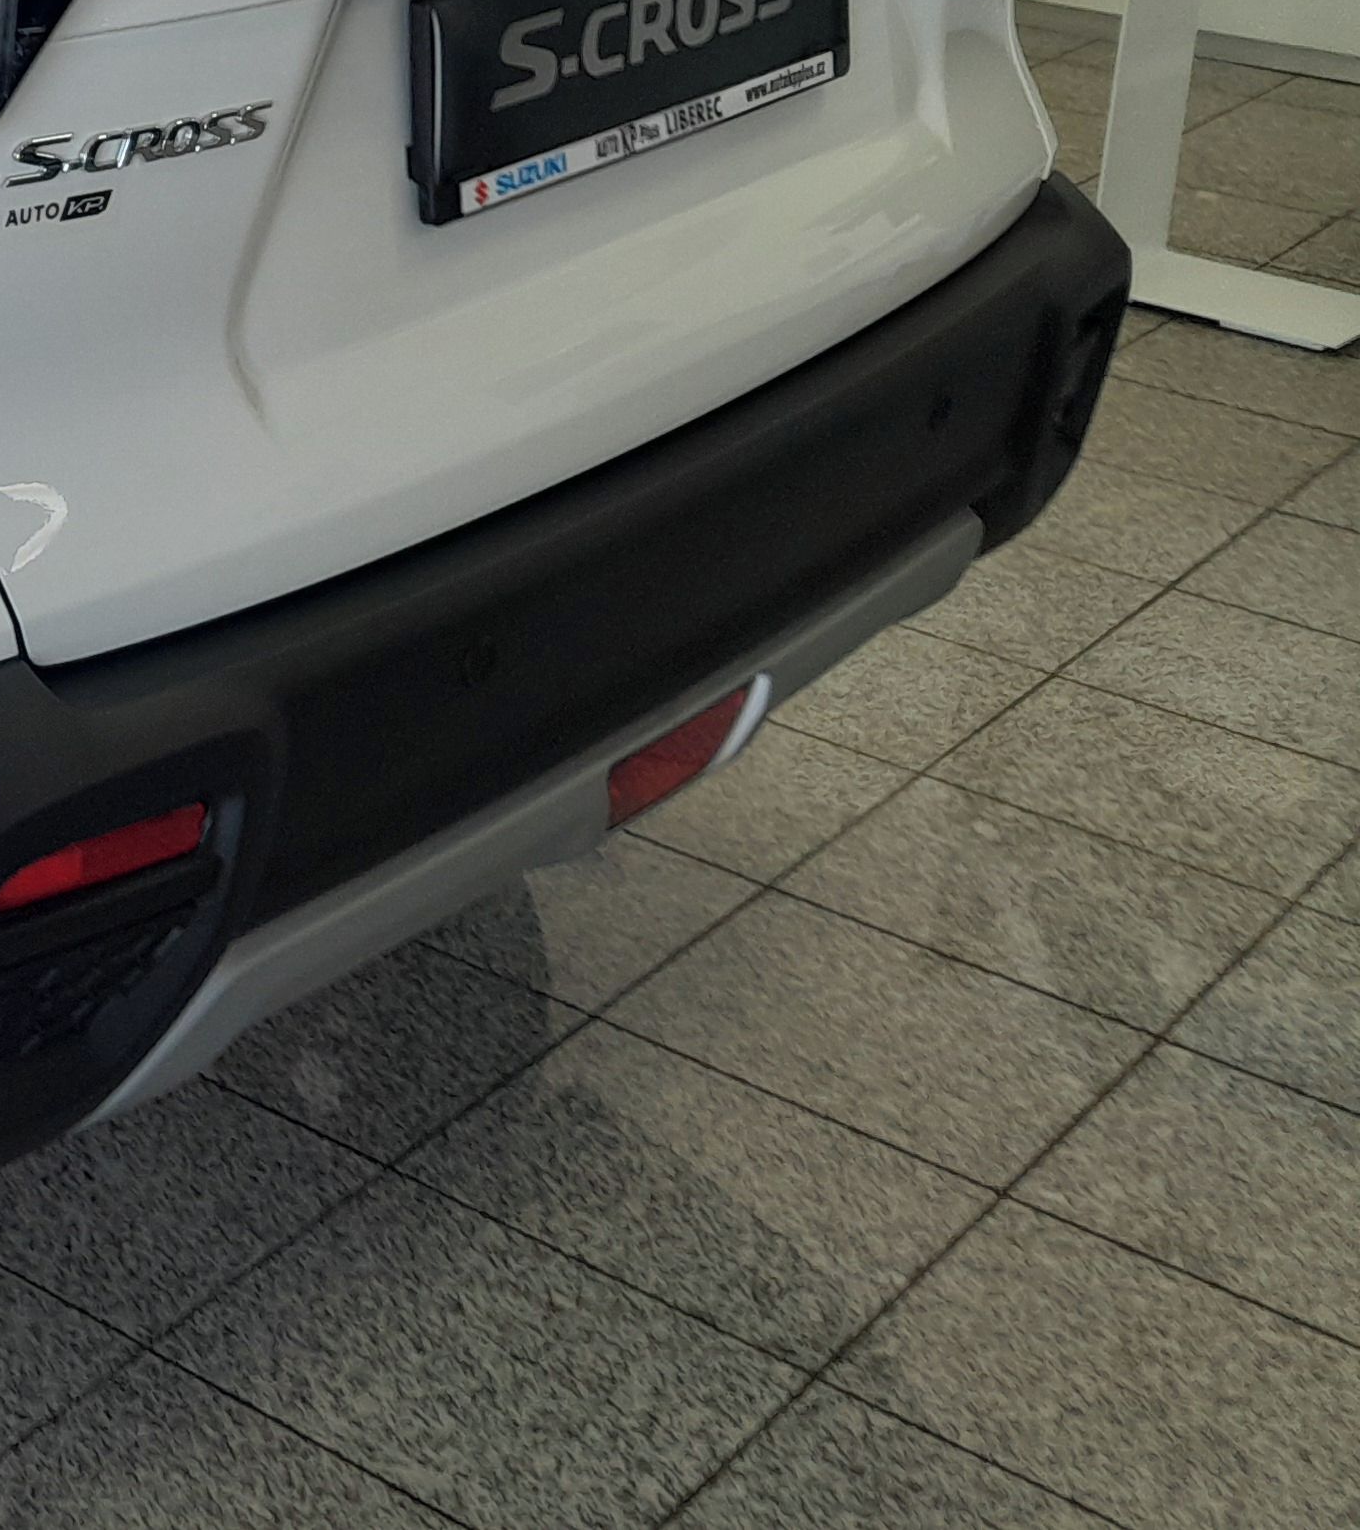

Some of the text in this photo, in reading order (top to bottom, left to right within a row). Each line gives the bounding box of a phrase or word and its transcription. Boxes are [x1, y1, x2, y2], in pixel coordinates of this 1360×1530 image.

[0, 99, 273, 188] S-CROSS
[495, 152, 567, 196] SUZUKI
[664, 96, 723, 135] LIBEREC
[5, 202, 60, 227] AUTO
